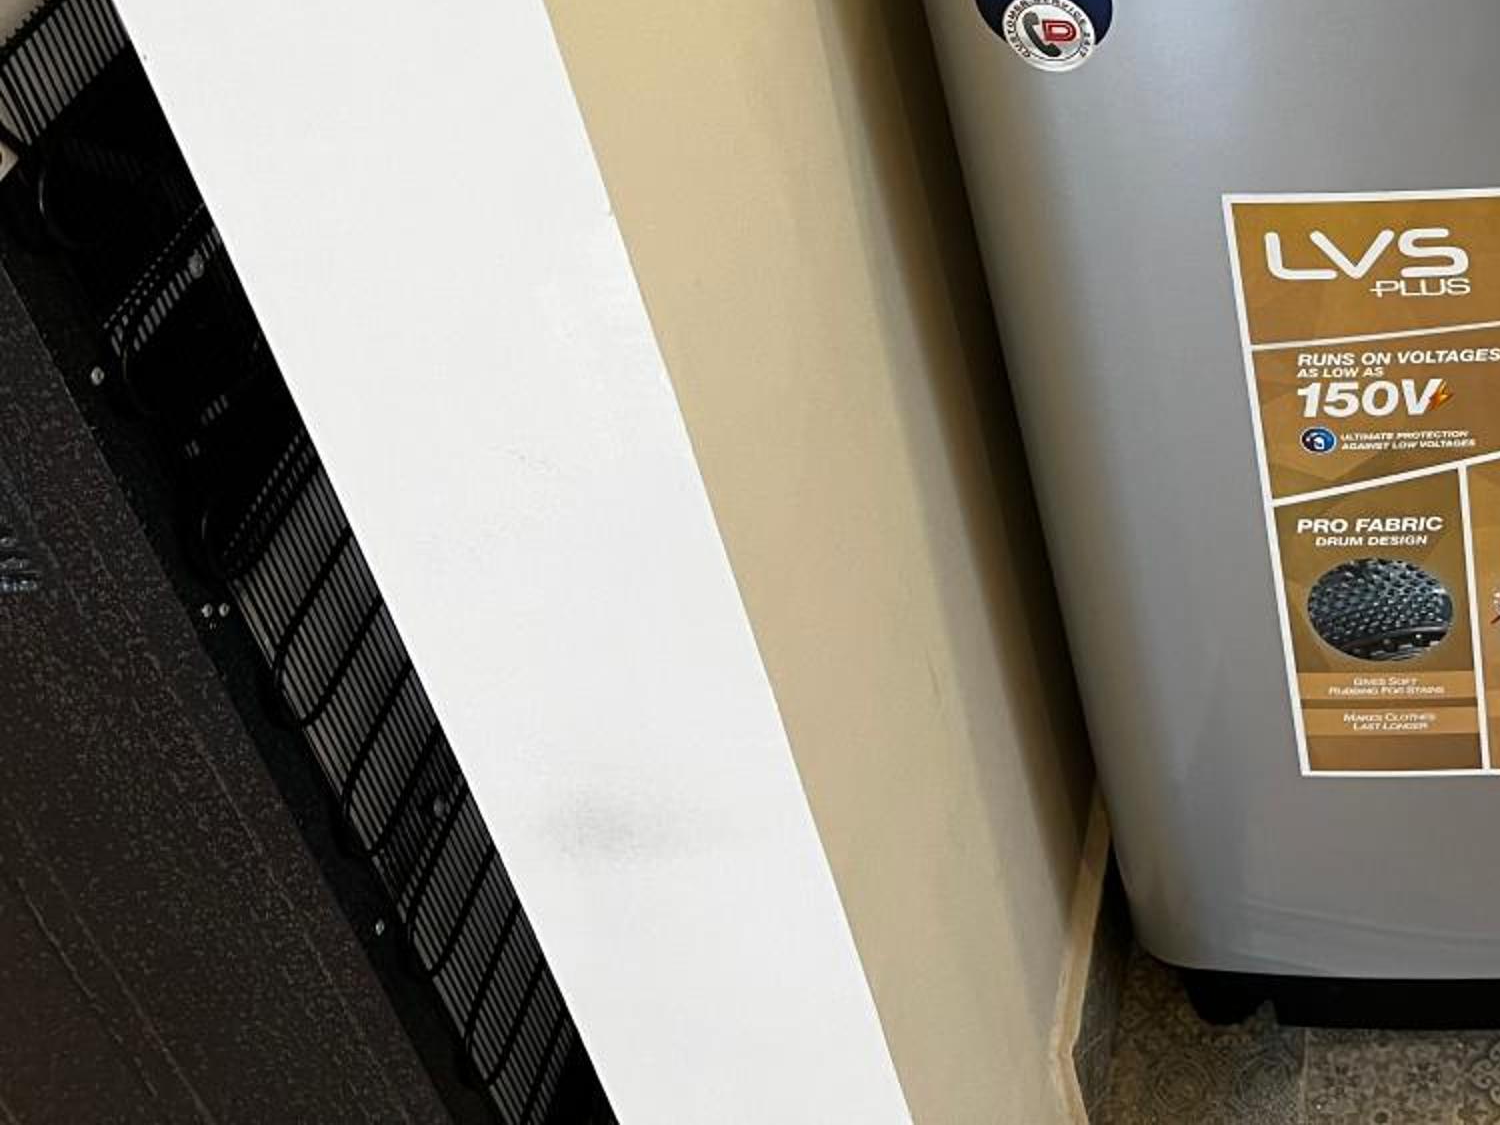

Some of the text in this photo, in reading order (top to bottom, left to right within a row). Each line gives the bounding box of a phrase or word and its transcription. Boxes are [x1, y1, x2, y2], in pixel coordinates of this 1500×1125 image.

[1264, 227, 1470, 281] LVS
[1370, 277, 1472, 299] PLUS
[1297, 352, 1356, 367] RUNS
[1361, 351, 1393, 366] ON
[1296, 365, 1385, 379] AS LOW AS
[1297, 377, 1444, 418] 150V
[1340, 429, 1470, 442] ULTIMATE PROTECTION
[1340, 438, 1477, 451] AGAINST LOW VOLTAGES
[1296, 515, 1445, 534] PRO FABRIC
[1314, 534, 1429, 547] DRUM DESIGN
